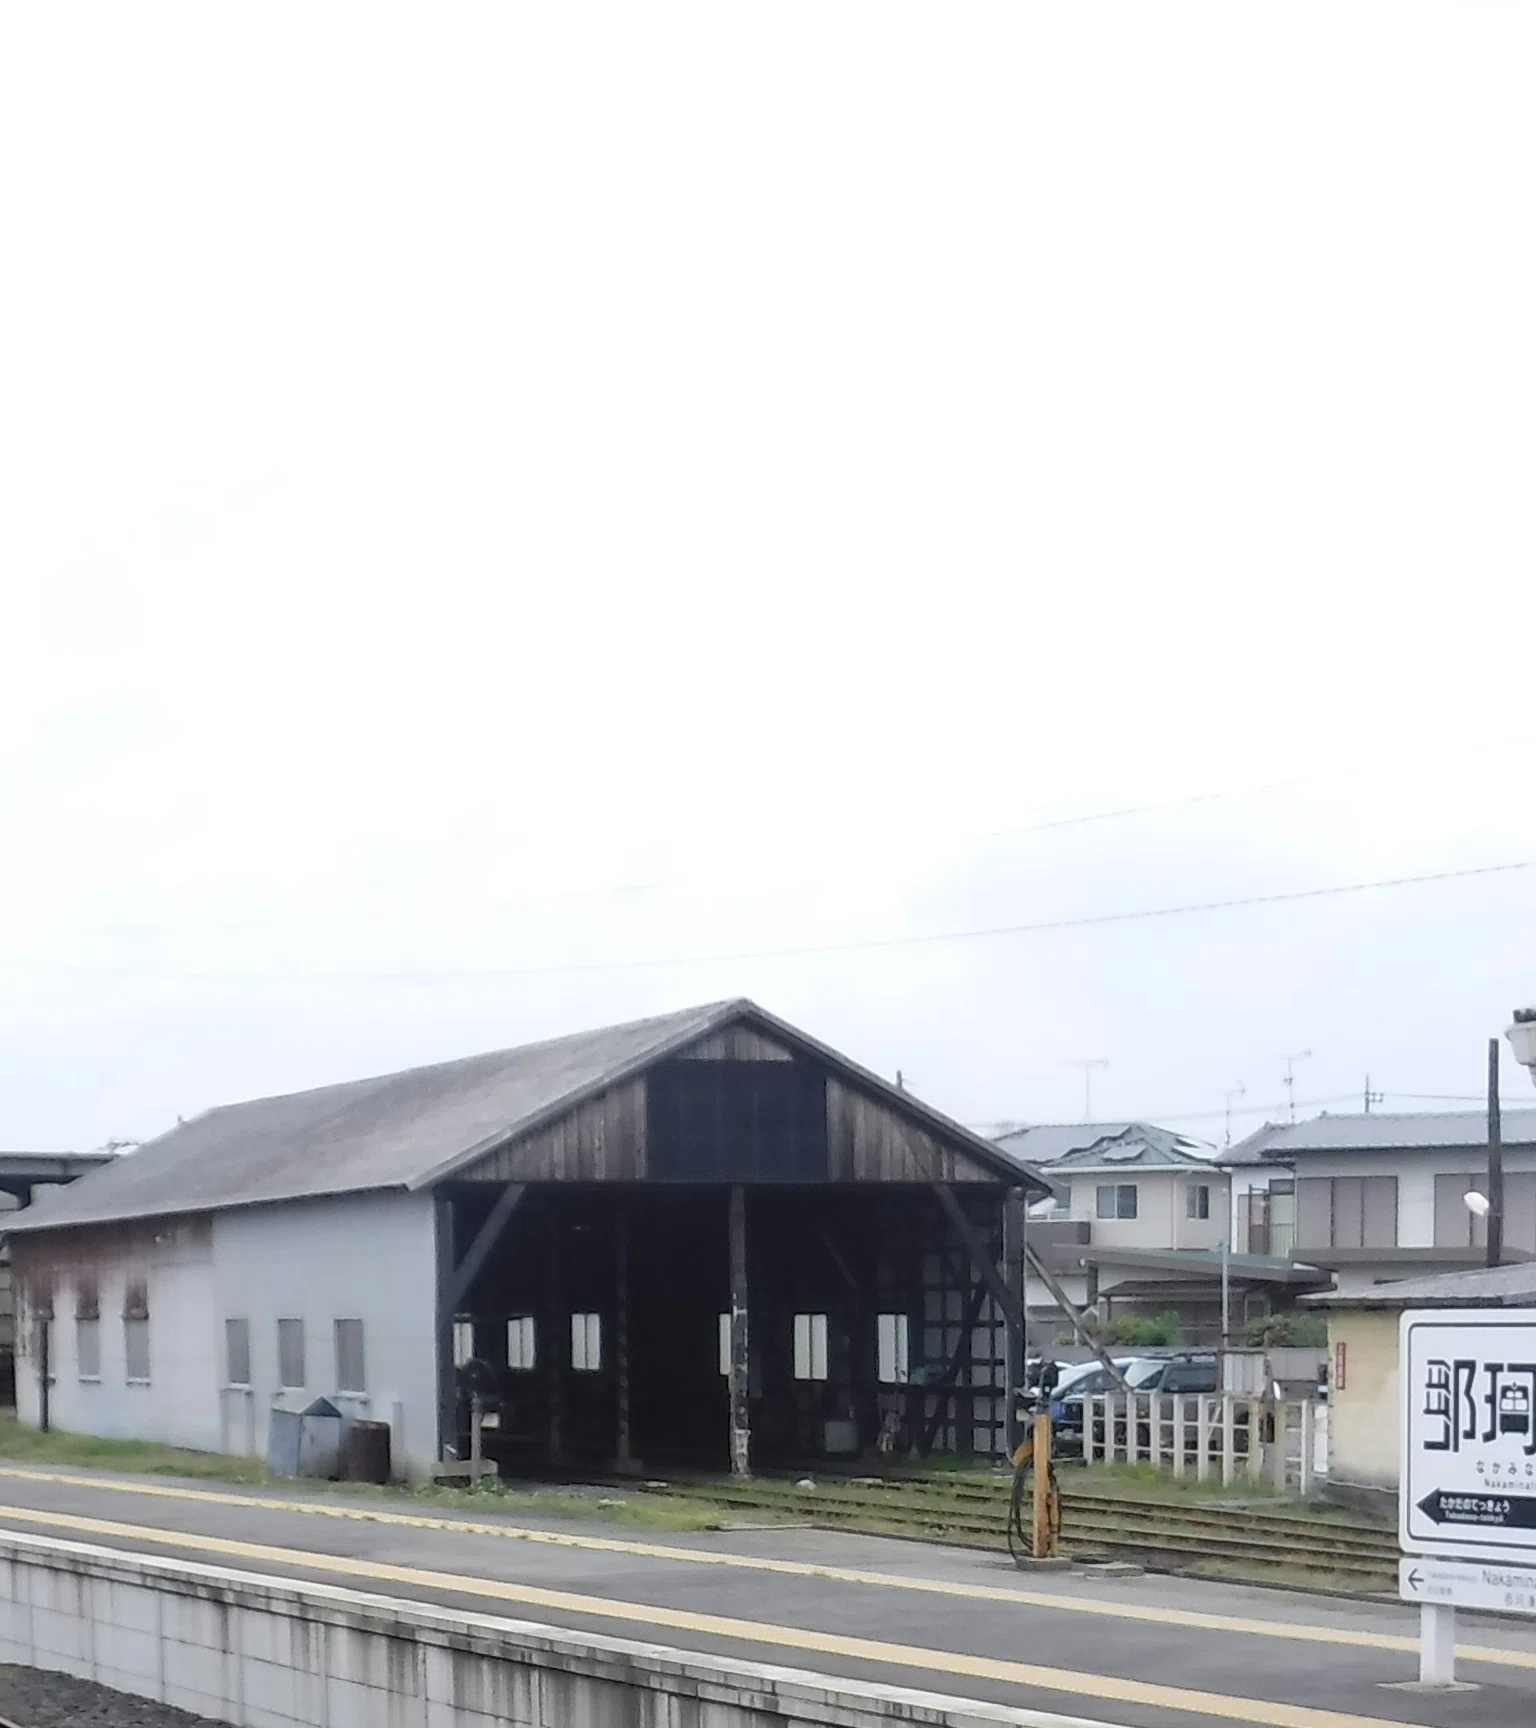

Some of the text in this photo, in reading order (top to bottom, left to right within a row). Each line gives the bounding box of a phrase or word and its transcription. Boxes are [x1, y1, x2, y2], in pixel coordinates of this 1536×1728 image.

[1438, 1495, 1511, 1514] たかだのてっきょう
